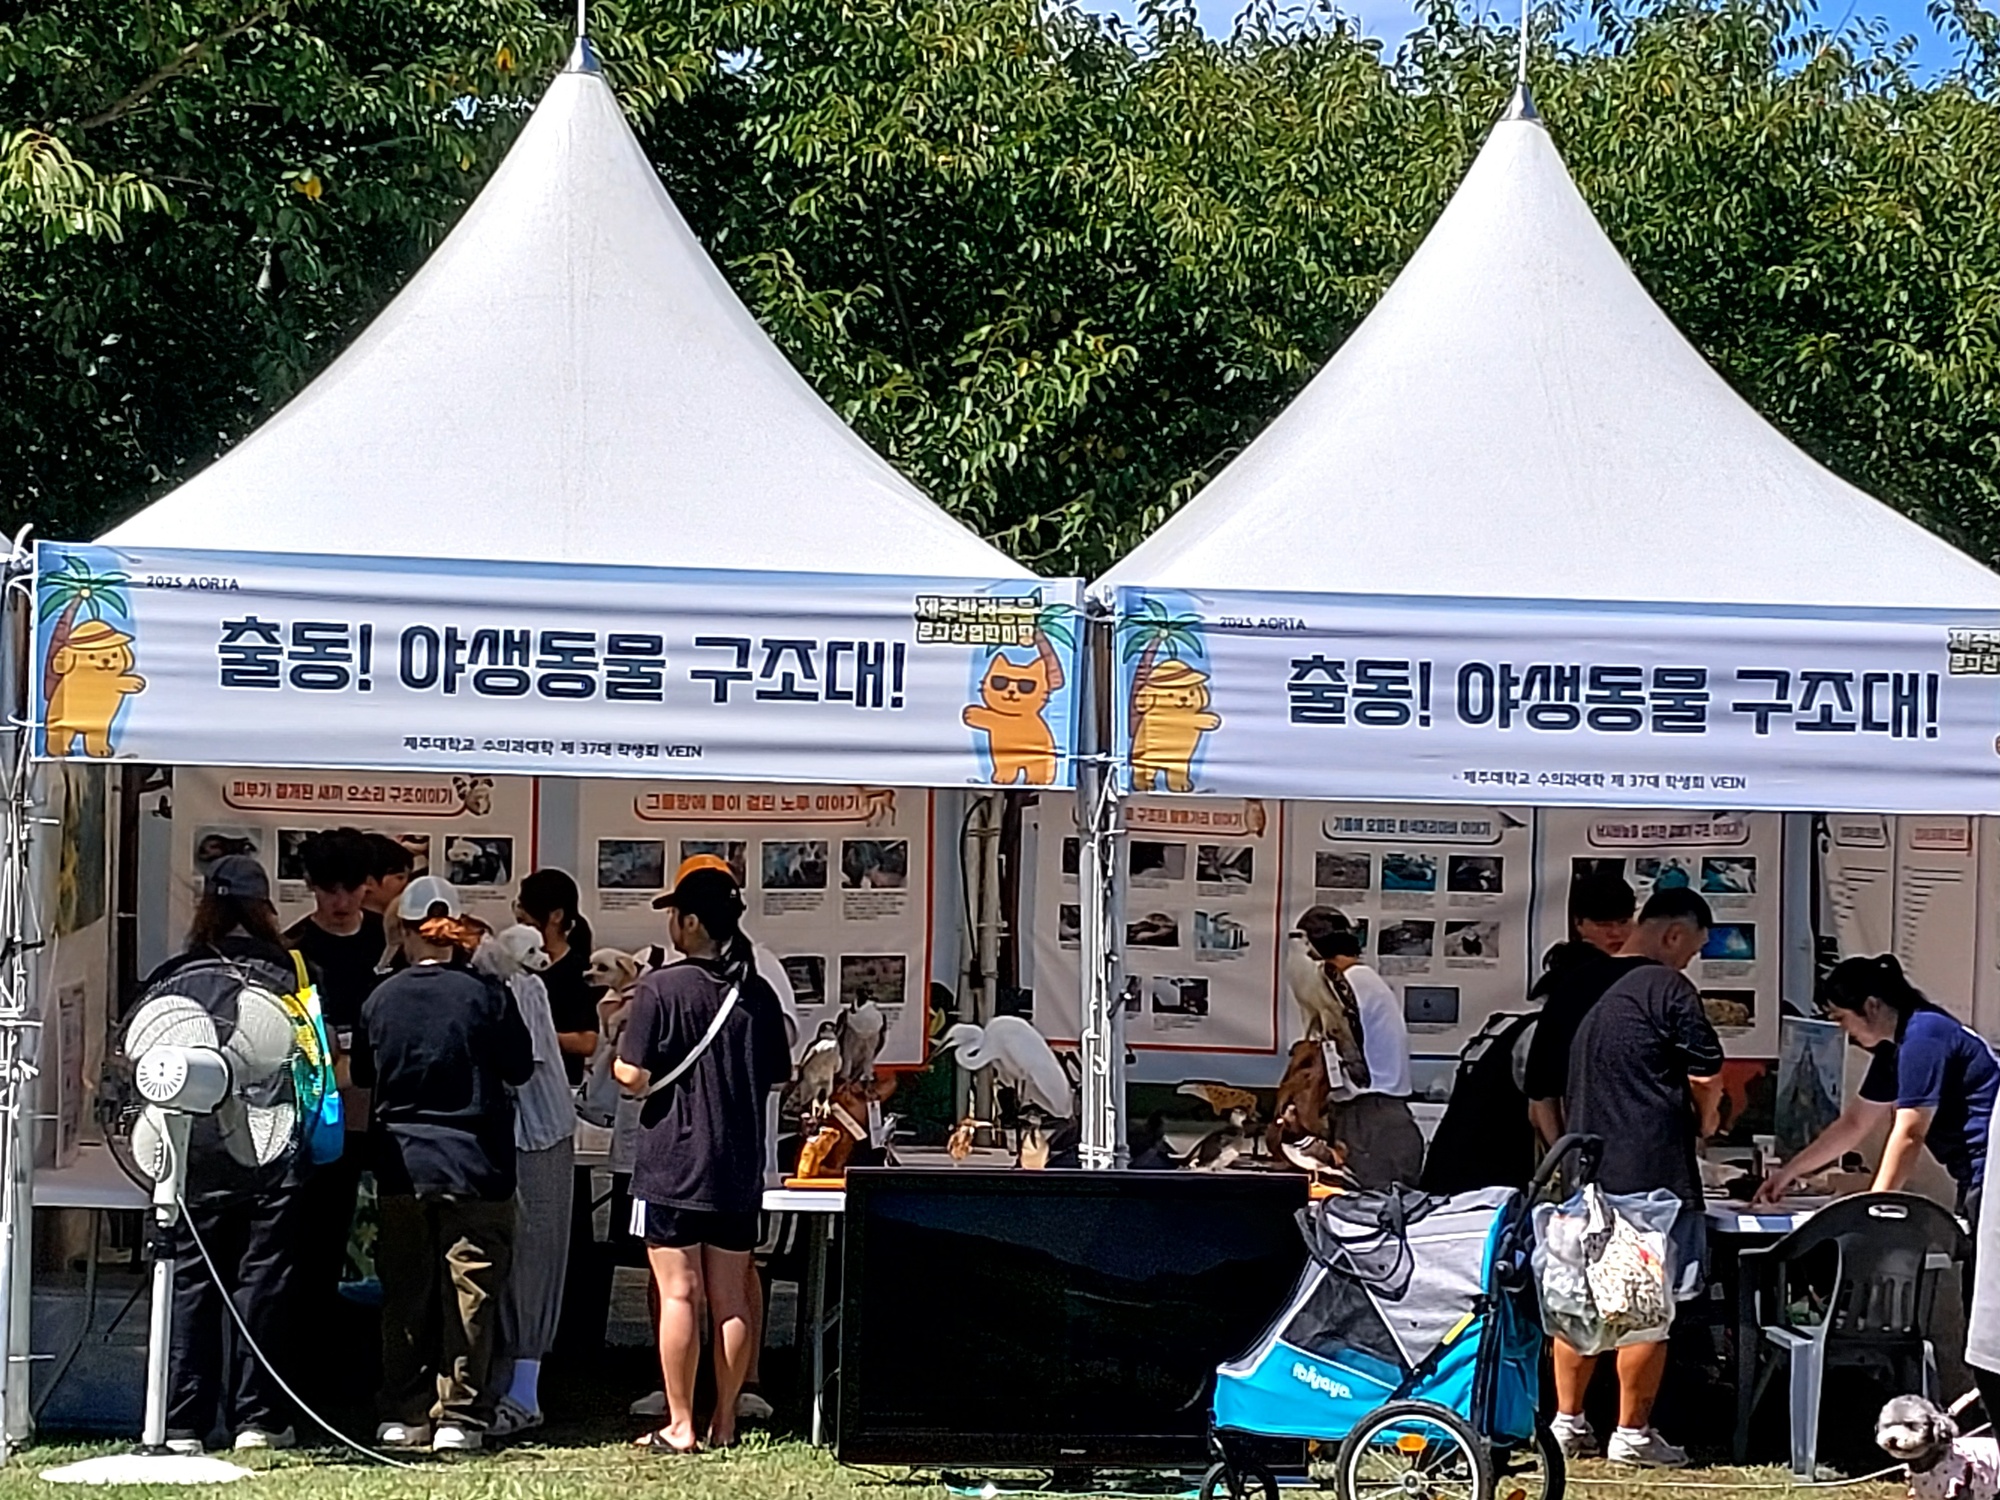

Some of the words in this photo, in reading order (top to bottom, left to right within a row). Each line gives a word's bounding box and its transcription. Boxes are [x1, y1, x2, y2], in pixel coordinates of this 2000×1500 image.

[147, 575, 183, 588] 2025
[1220, 616, 1253, 629] 2025
[1258, 617, 1307, 631] AORTA
[218, 614, 374, 691] 출동!
[401, 623, 667, 702] 야생동물
[690, 637, 906, 709] 구조대!
[1287, 653, 1433, 728] 출동!
[1456, 661, 1710, 734] 야생동물
[1731, 668, 1940, 739] 구조대!
[403, 737, 477, 752] 제주대학교
[482, 739, 554, 756] 수의과대학
[561, 741, 575, 754] 제
[580, 742, 612, 756] 37대
[617, 743, 659, 758] 학생회
[664, 745, 703, 757] VEIN
[1463, 771, 1531, 786] 제주대학교
[1537, 772, 1605, 788] 수의과대학
[1611, 774, 1625, 787] 제
[1629, 774, 1660, 788] 37대
[1665, 775, 1705, 790] 학생회
[1710, 776, 1746, 789] VEIN
[232, 781, 272, 799] 피부가
[346, 784, 386, 803] 오소리
